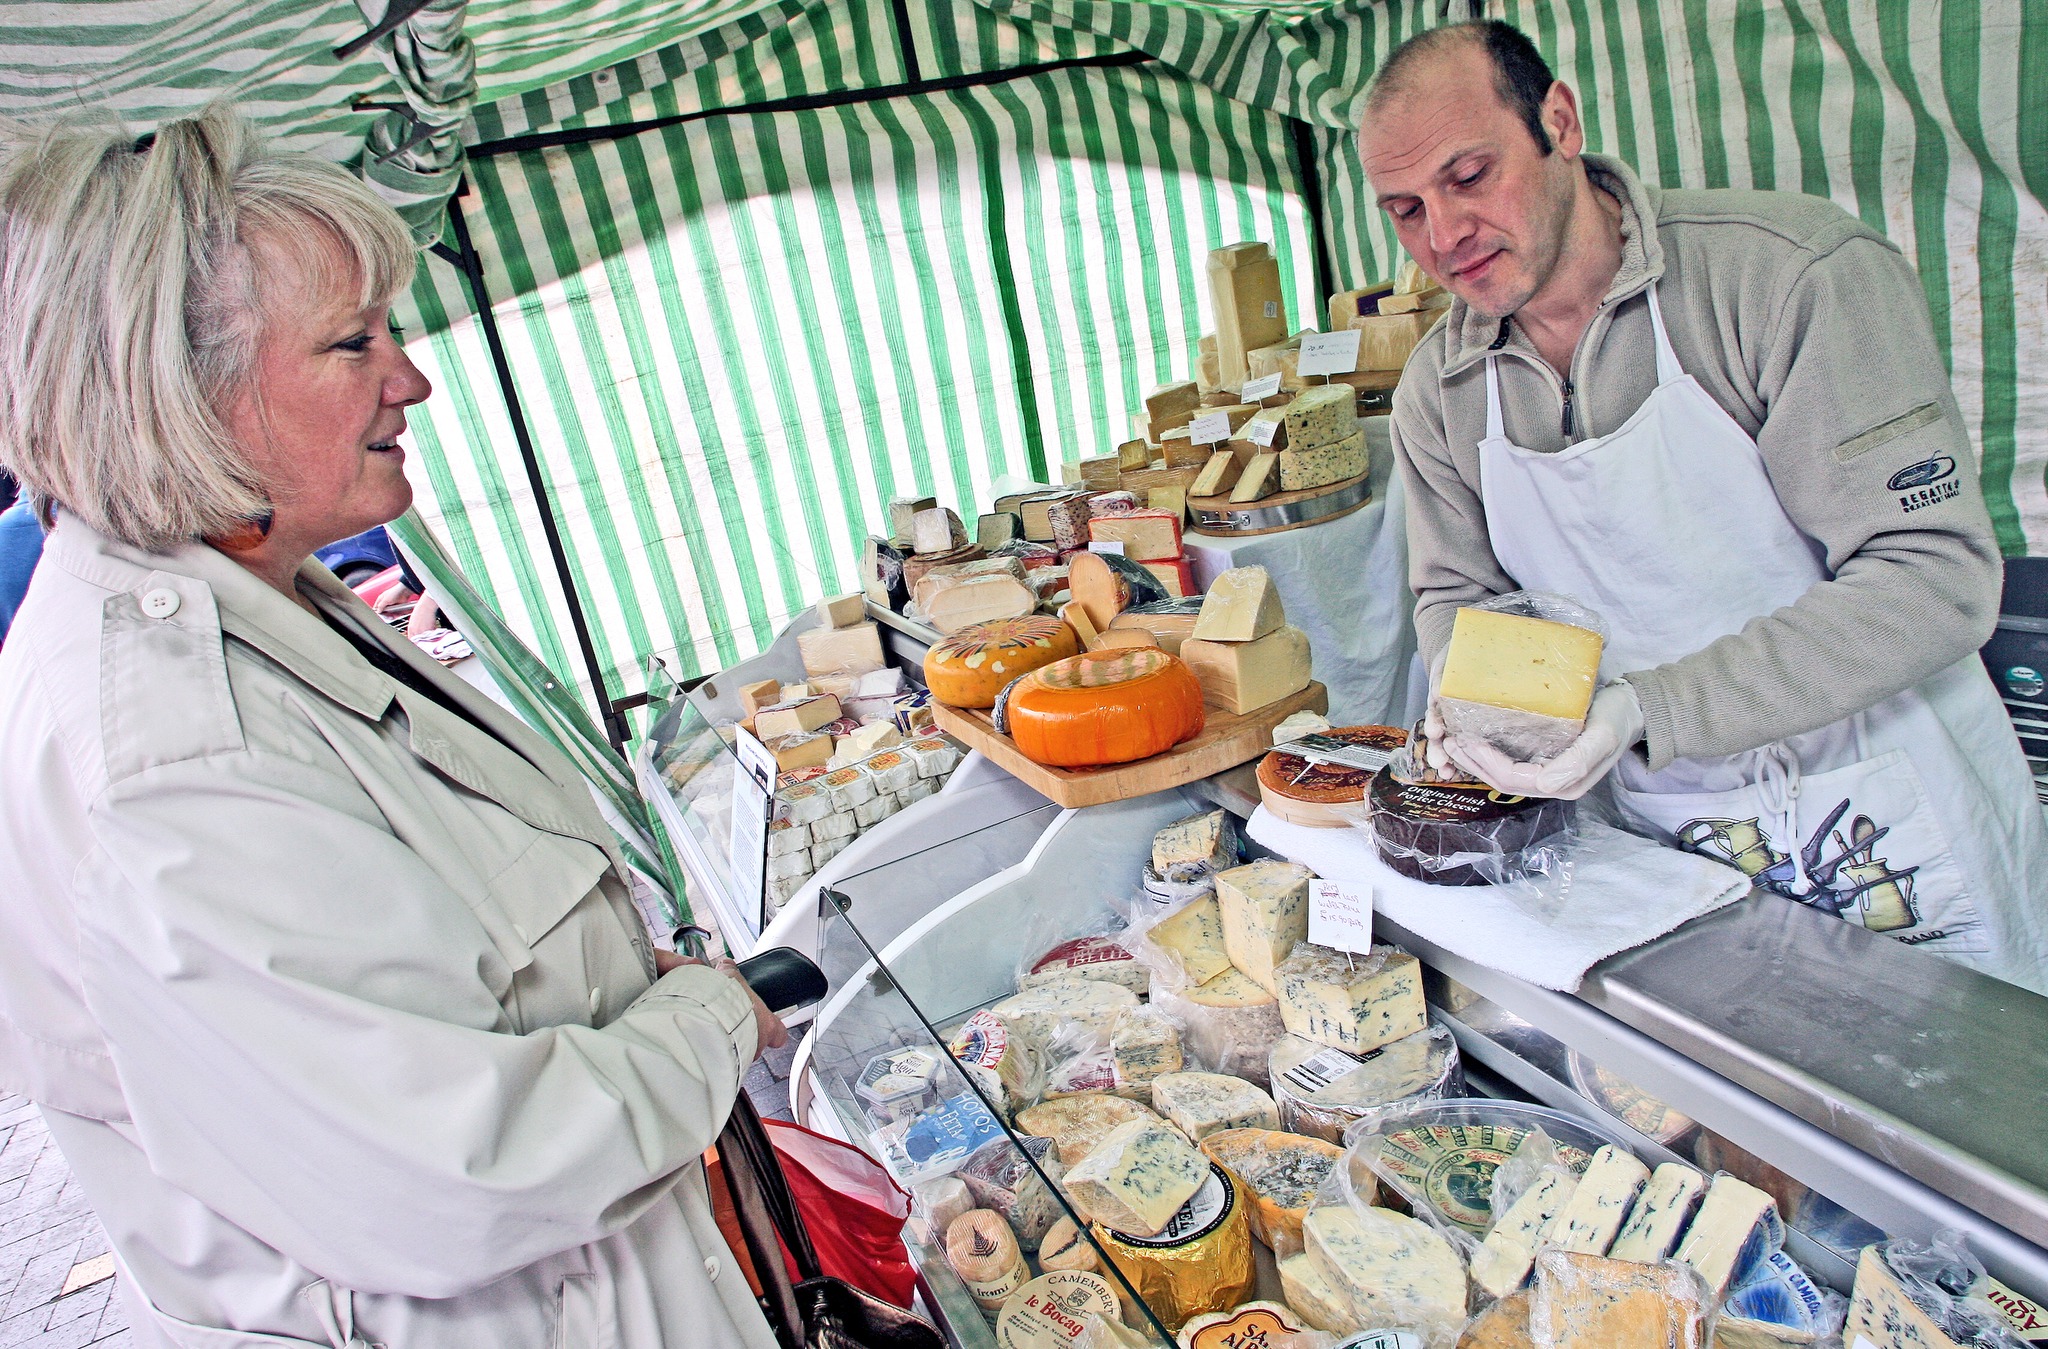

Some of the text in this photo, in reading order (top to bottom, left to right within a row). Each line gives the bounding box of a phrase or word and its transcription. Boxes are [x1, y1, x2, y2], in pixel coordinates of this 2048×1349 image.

[1397, 791, 1436, 805] Porter
[1437, 799, 1480, 813] Cheese
[1407, 786, 1486, 806] Original Irish
[938, 1110, 966, 1138] FETA
[1769, 1252, 1792, 1273] OLA
[1048, 1275, 1114, 1315] CAMEMBERT
[1024, 1294, 1039, 1308] le
[1040, 1302, 1084, 1338] Bocag
